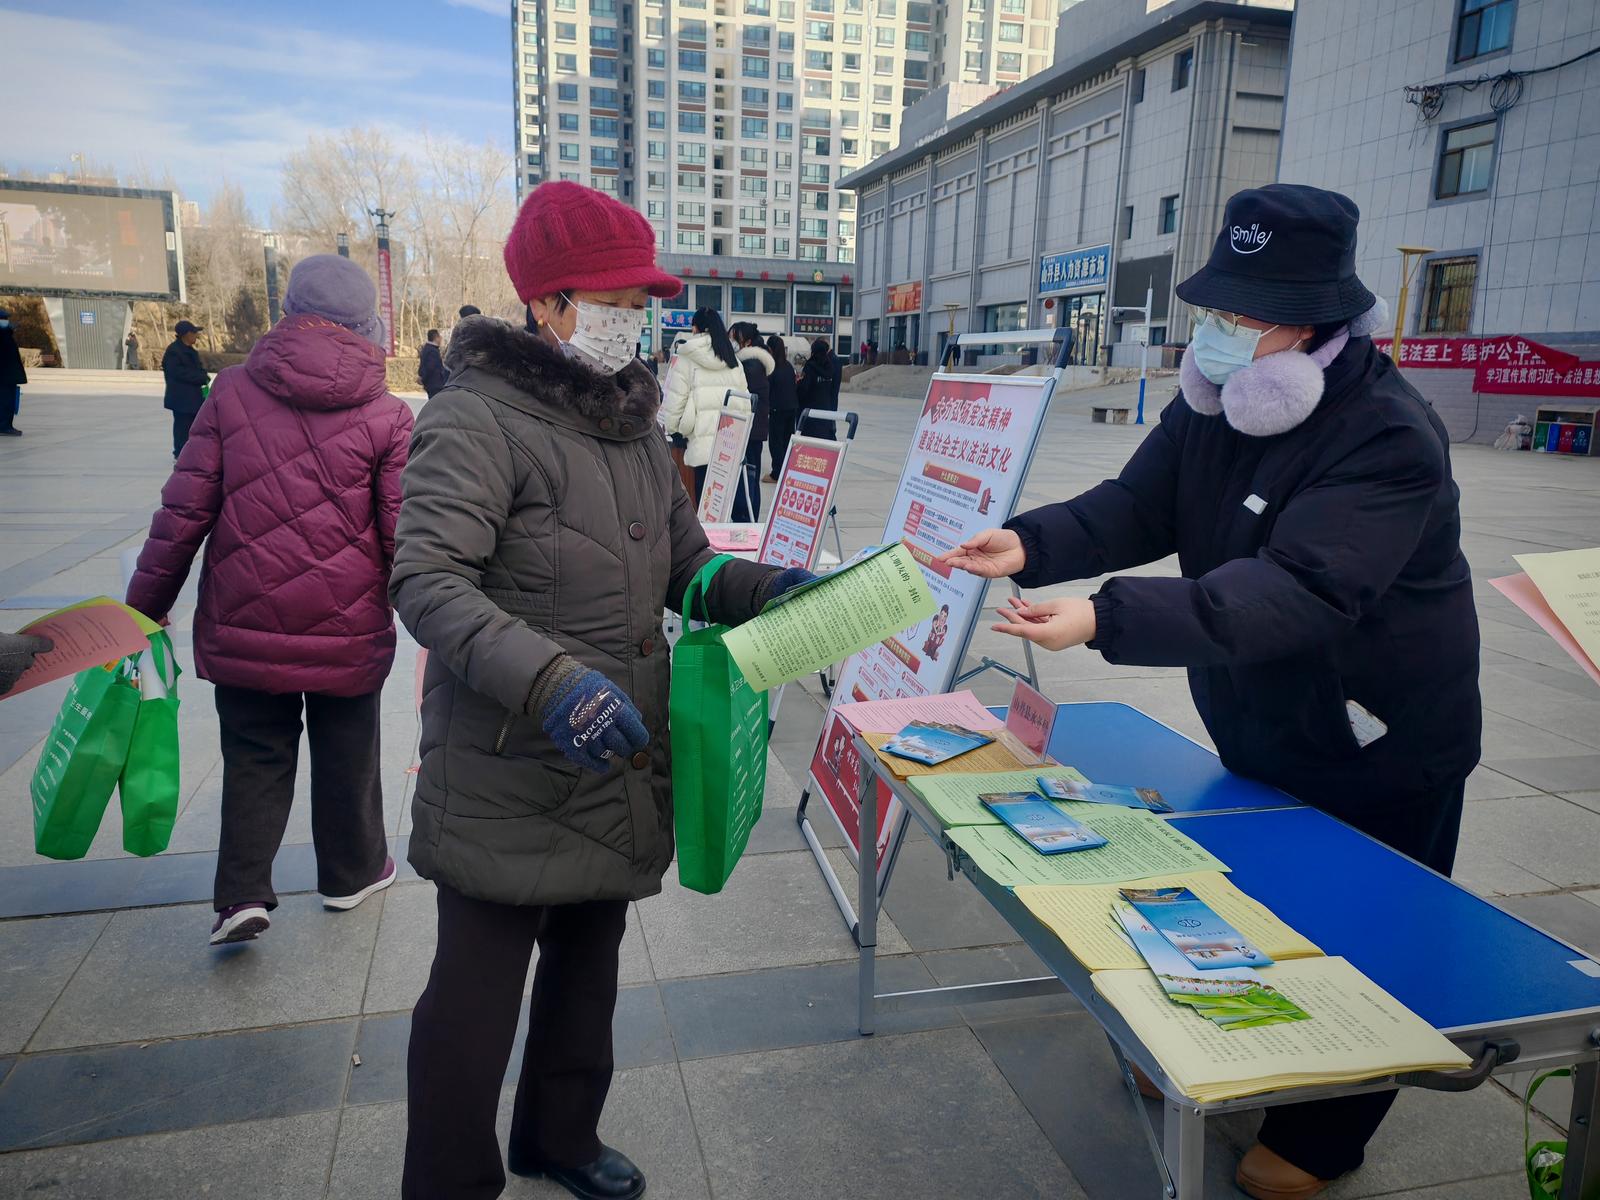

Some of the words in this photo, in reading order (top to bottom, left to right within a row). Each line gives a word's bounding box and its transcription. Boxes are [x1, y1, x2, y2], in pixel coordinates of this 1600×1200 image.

[1041, 254, 1105, 284] 山丹县人力资源市场
[933, 397, 1012, 431] 大力弘扬宪法精神
[918, 429, 1012, 473] 建设社会主义法治文化
